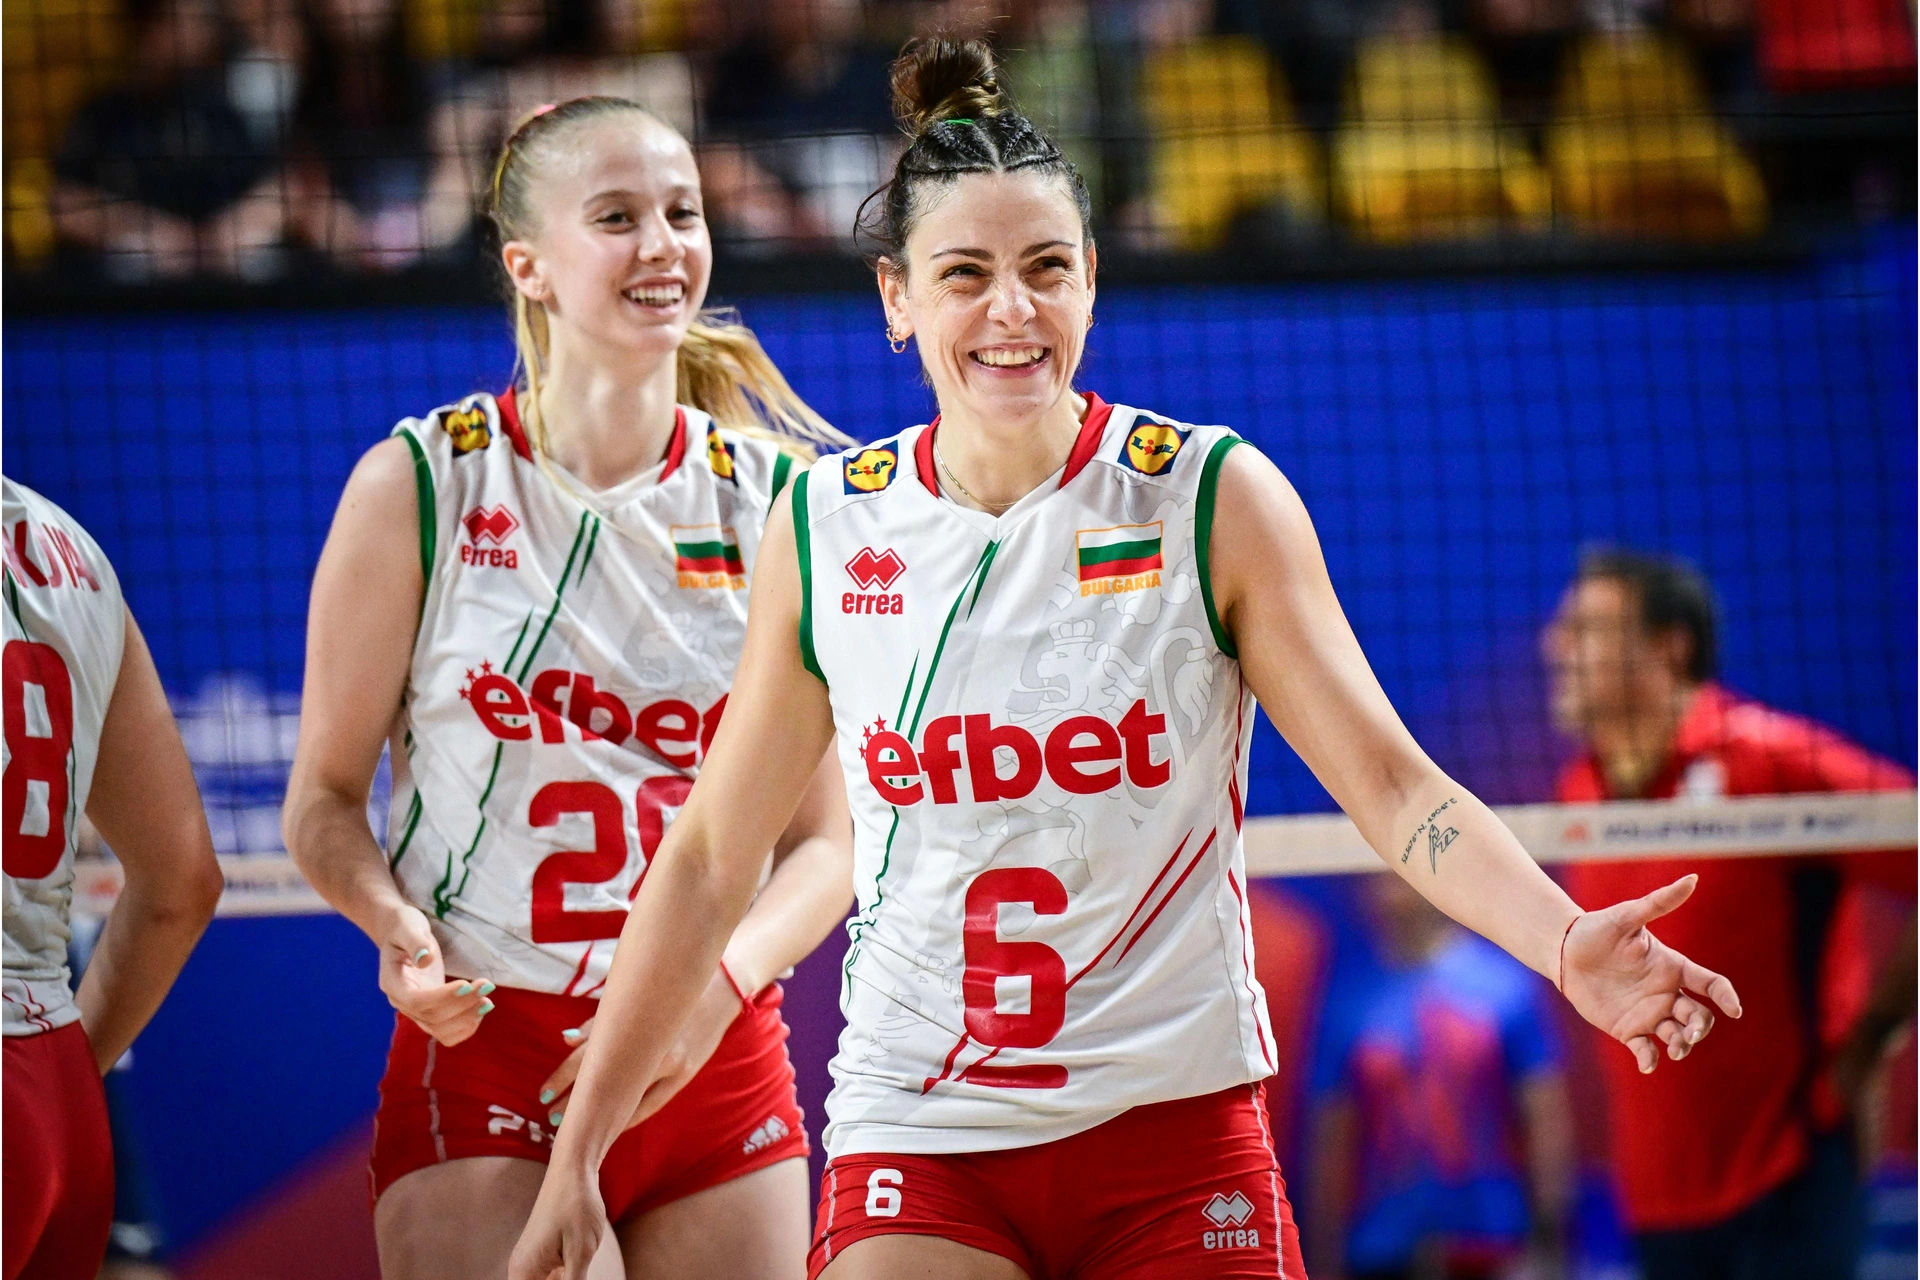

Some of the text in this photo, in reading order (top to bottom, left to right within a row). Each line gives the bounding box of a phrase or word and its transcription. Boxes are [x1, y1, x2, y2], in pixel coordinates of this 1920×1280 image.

[461, 545, 518, 569] errea
[1081, 572, 1162, 597] BULGARIA
[842, 592, 903, 615] errea
[864, 698, 1171, 806] efbet
[962, 867, 1069, 1049] 6
[865, 1168, 904, 1218] 6
[1203, 1228, 1260, 1250] errea
